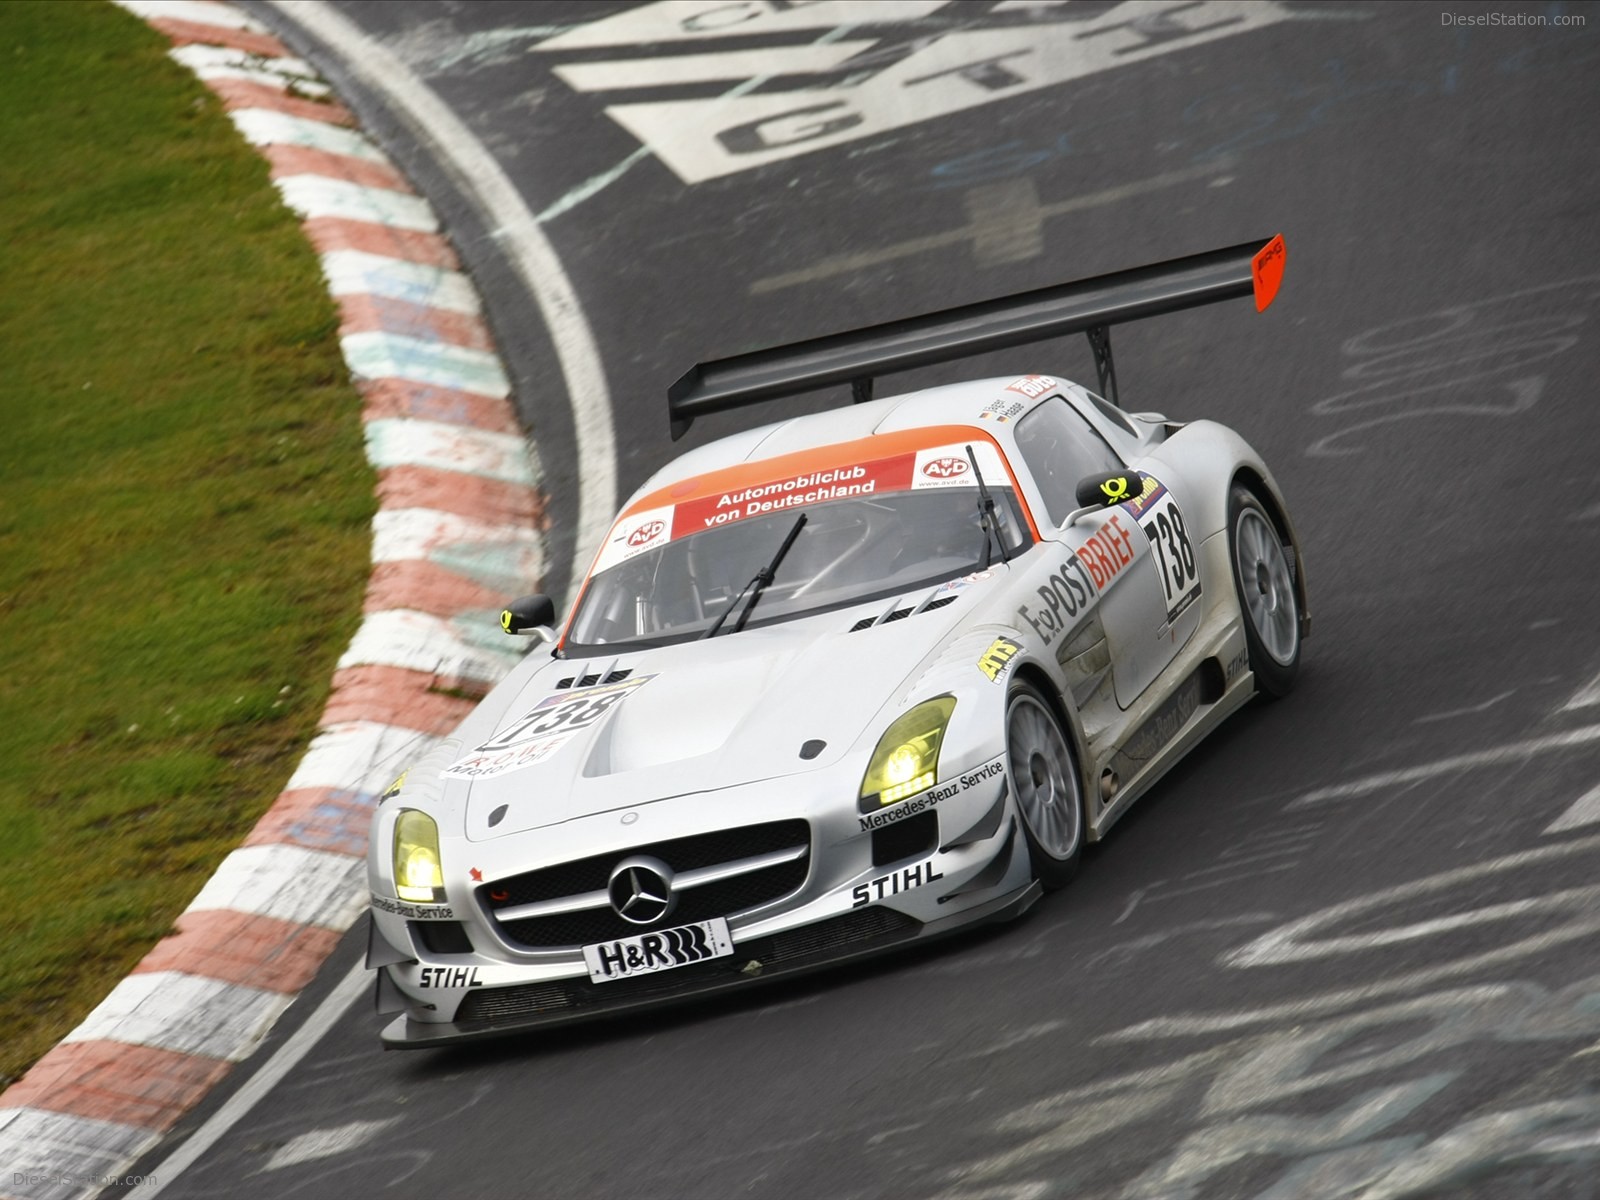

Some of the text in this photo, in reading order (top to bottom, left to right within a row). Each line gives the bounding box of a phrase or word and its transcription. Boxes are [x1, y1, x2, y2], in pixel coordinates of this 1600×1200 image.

[704, 479, 876, 527] von Deutschland
[716, 465, 866, 509] Automobilclub
[1143, 501, 1197, 601] 738
[1226, 647, 1250, 681] STIHL
[497, 690, 628, 744] 738
[446, 761, 513, 776] Motor
[858, 760, 1004, 832] Mercedes-Benz Service
[852, 861, 944, 909] STIHL
[416, 905, 453, 919] Service
[419, 967, 483, 988] STIHL
